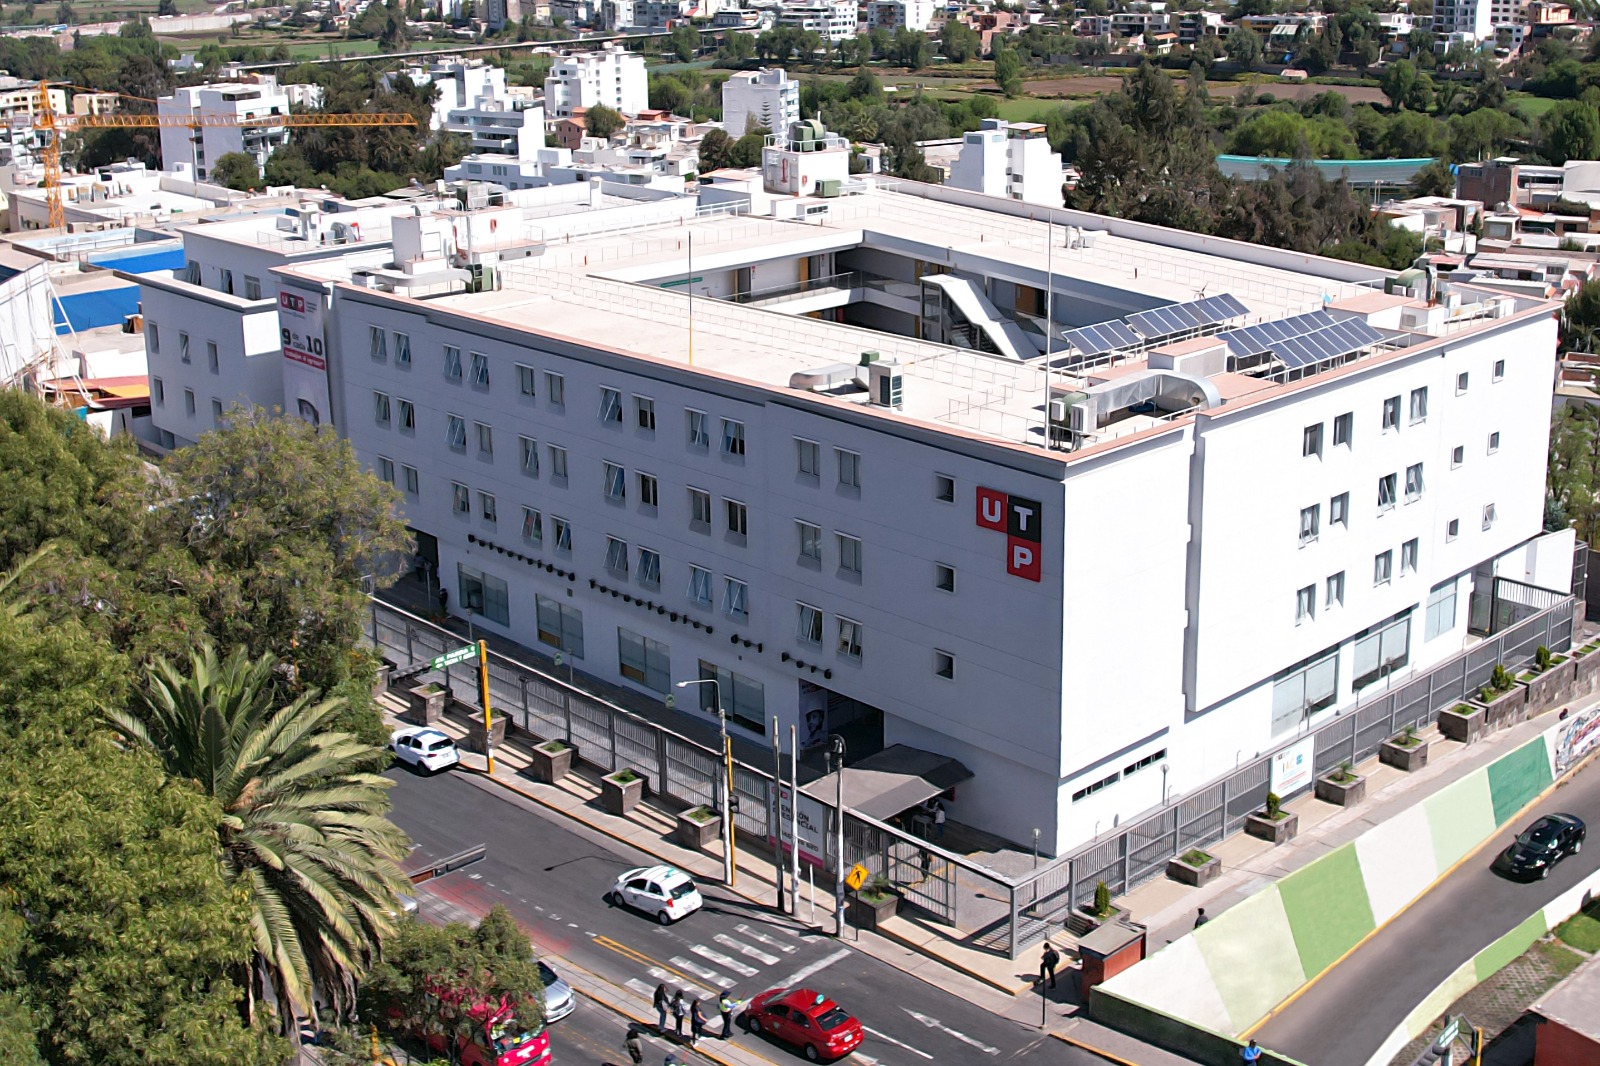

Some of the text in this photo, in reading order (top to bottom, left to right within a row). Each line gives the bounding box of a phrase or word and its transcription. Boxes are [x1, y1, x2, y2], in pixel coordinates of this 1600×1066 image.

[281, 295, 304, 310] UTP
[282, 328, 291, 345] 9
[306, 335, 323, 356] 10
